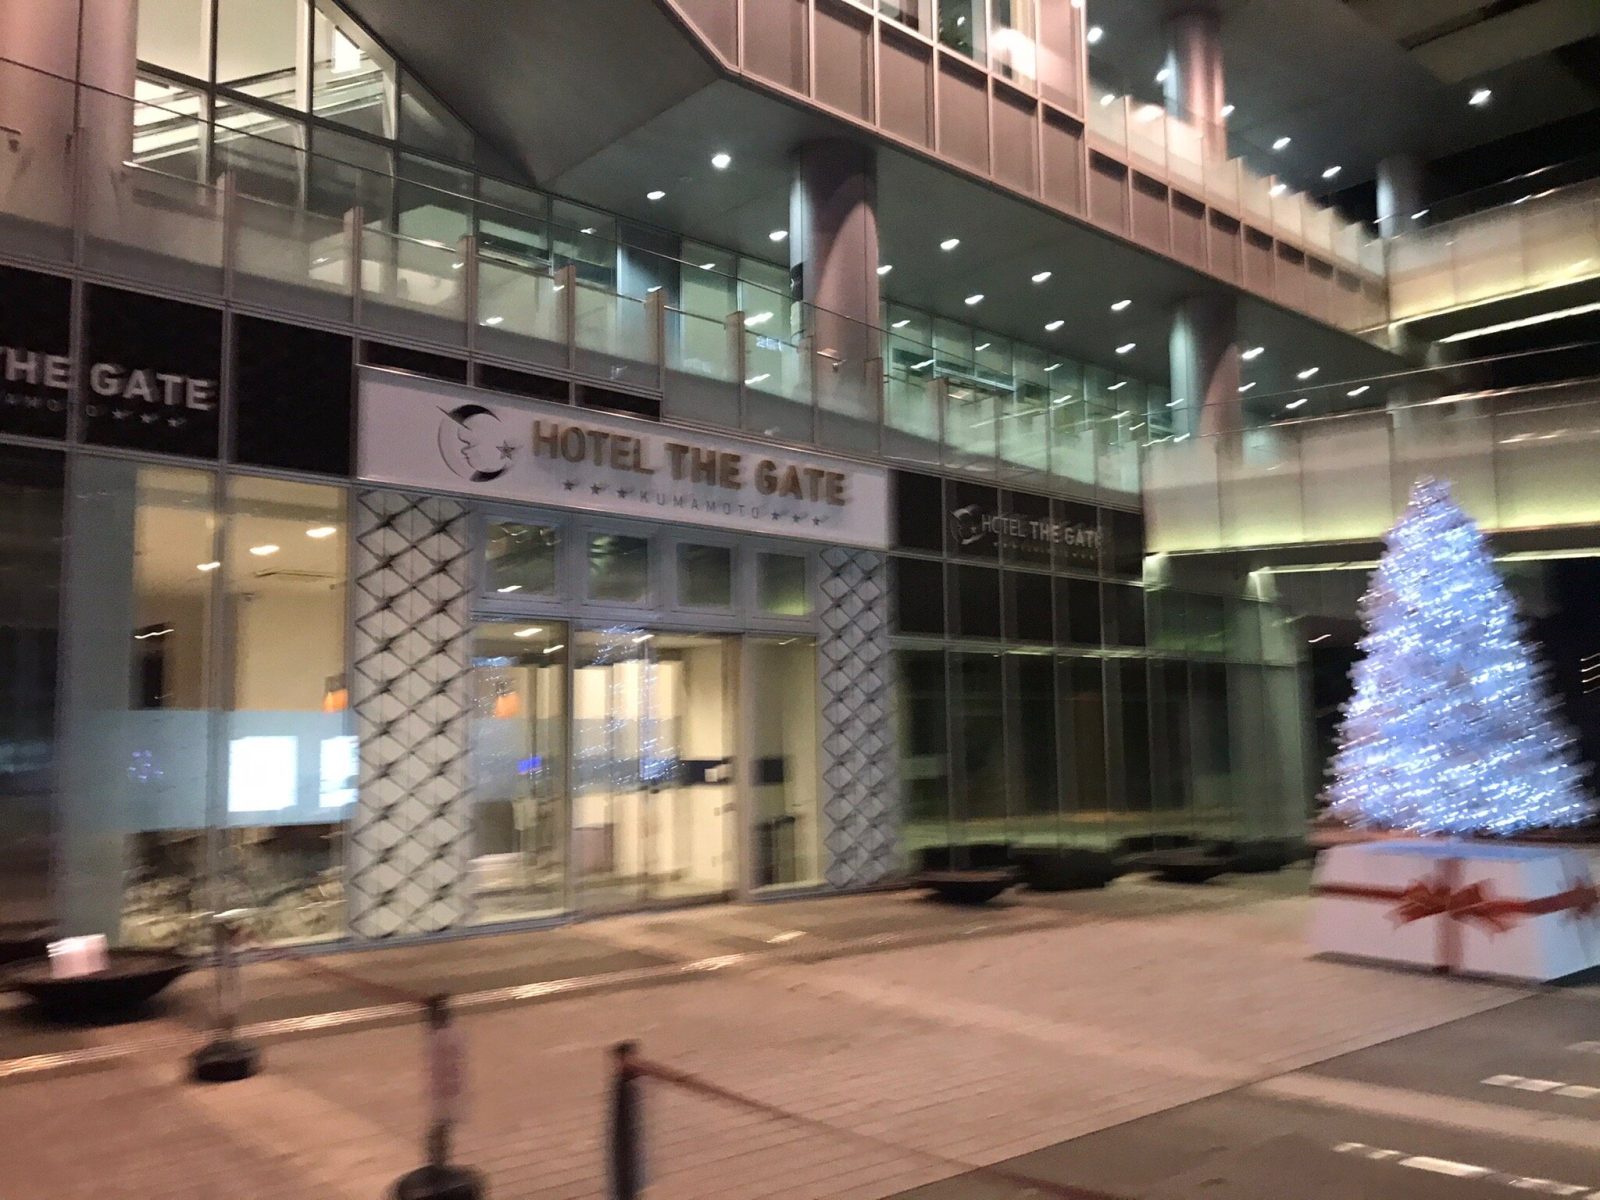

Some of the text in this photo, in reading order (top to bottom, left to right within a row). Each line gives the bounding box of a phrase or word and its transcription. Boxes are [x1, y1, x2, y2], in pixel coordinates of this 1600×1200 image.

[0, 346, 72, 389] HE
[89, 362, 211, 411] GATE
[532, 421, 846, 506] HOTEL THE GATE
[640, 490, 760, 519] KUMAMOTO
[982, 513, 1026, 538] HOTEL
[1030, 521, 1060, 543] THE
